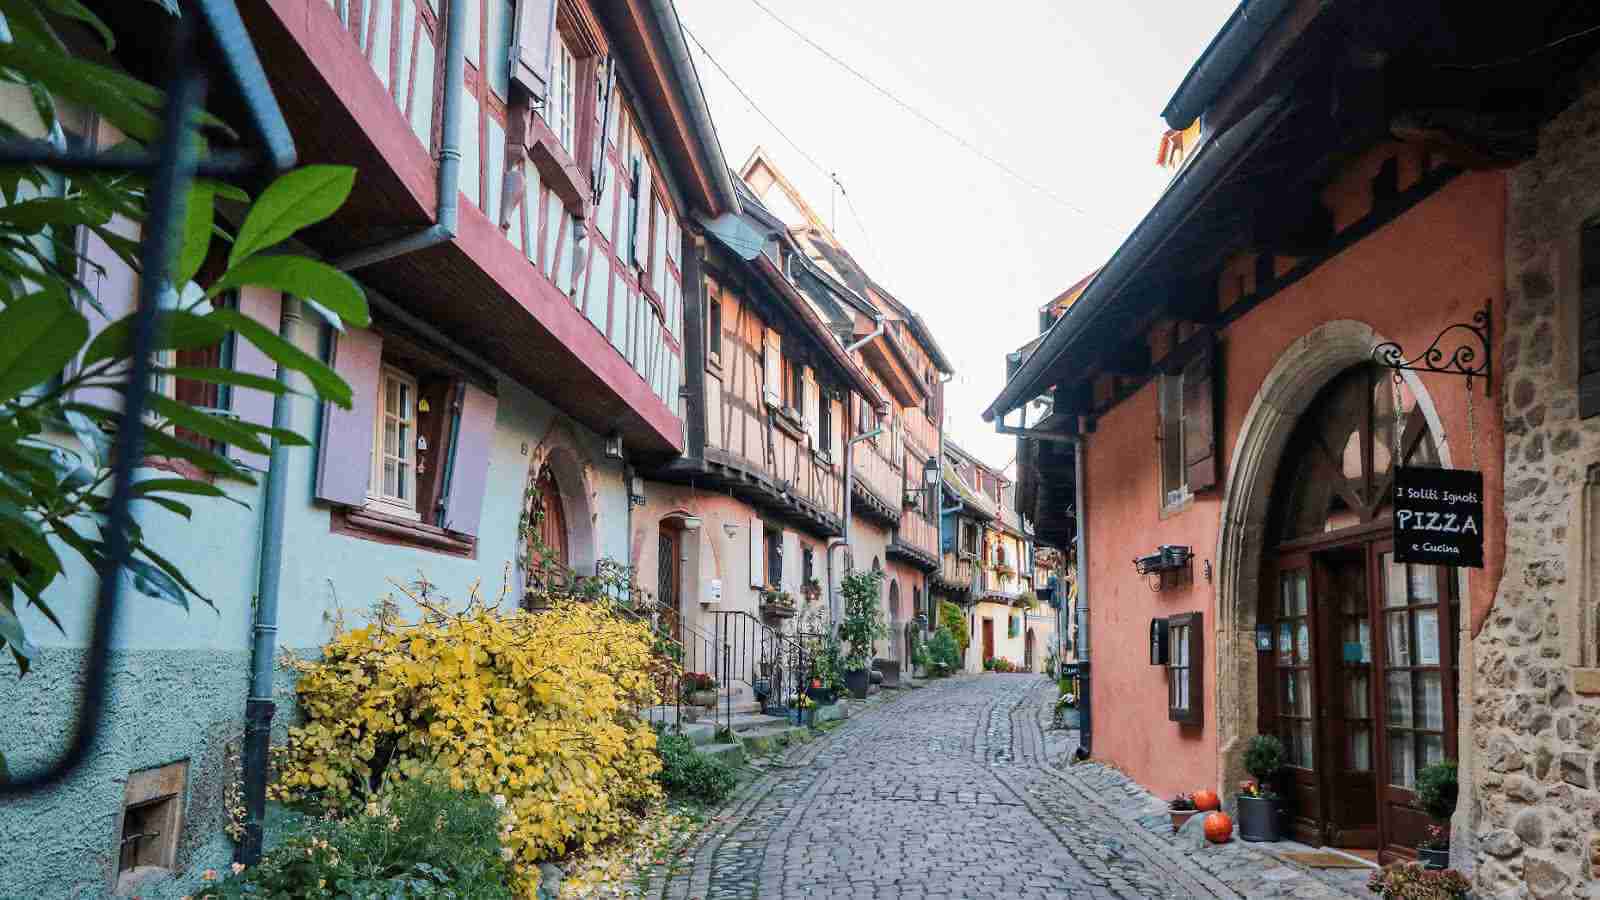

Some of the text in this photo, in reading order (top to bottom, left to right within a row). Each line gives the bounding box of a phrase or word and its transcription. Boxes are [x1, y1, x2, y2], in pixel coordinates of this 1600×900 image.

[1397, 487, 1478, 504] I Soliti Ignoti
[1397, 509, 1478, 535] PIZZA
[1412, 542, 1459, 553] e Cucina
